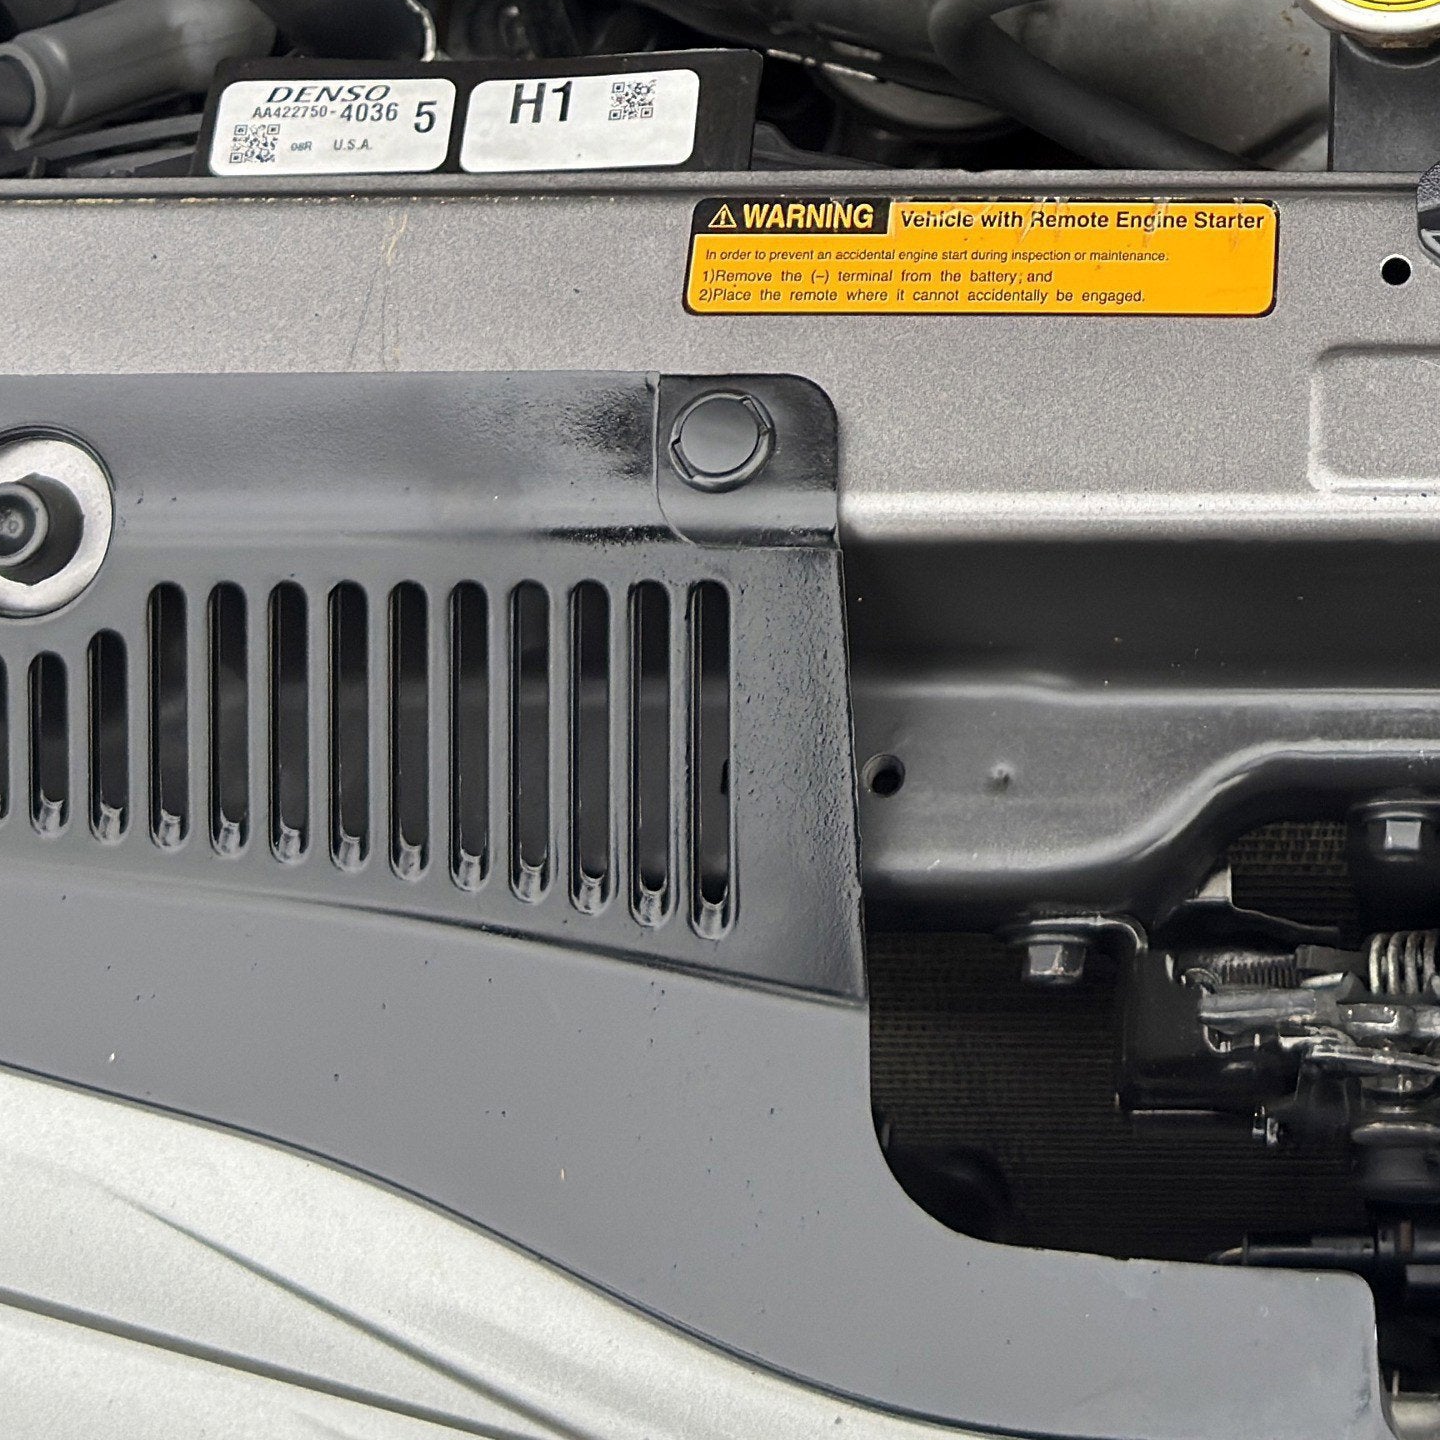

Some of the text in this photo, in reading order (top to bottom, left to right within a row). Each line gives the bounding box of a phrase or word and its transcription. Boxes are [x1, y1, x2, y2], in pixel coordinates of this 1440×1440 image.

[265, 85, 392, 104] DENSO
[509, 80, 574, 125] H1
[252, 100, 438, 134] AA422750-4036 5
[333, 139, 373, 151] U.S.A.
[744, 204, 874, 230] WARNING
[901, 210, 1265, 233] Vehicle with Remote Engine Starter
[706, 248, 717, 261] In
[720, 248, 751, 261] order
[754, 249, 766, 261] to
[768, 249, 814, 264] prevent
[817, 252, 831, 262] an
[834, 249, 895, 262] accidental
[898, 249, 935, 265] engine
[938, 249, 968, 262] start
[970, 249, 1008, 265] during
[1011, 249, 1070, 265] inspection
[1074, 252, 1087, 262] or
[702, 269, 774, 284] 1)Remove
[780, 270, 803, 283] the
[838, 270, 894, 284] terminal
[900, 269, 932, 284] from
[940, 269, 962, 284] the
[1026, 269, 1053, 284] and
[698, 288, 1146, 306] 2)Place the remote where it cannot accidentally be engaged.
